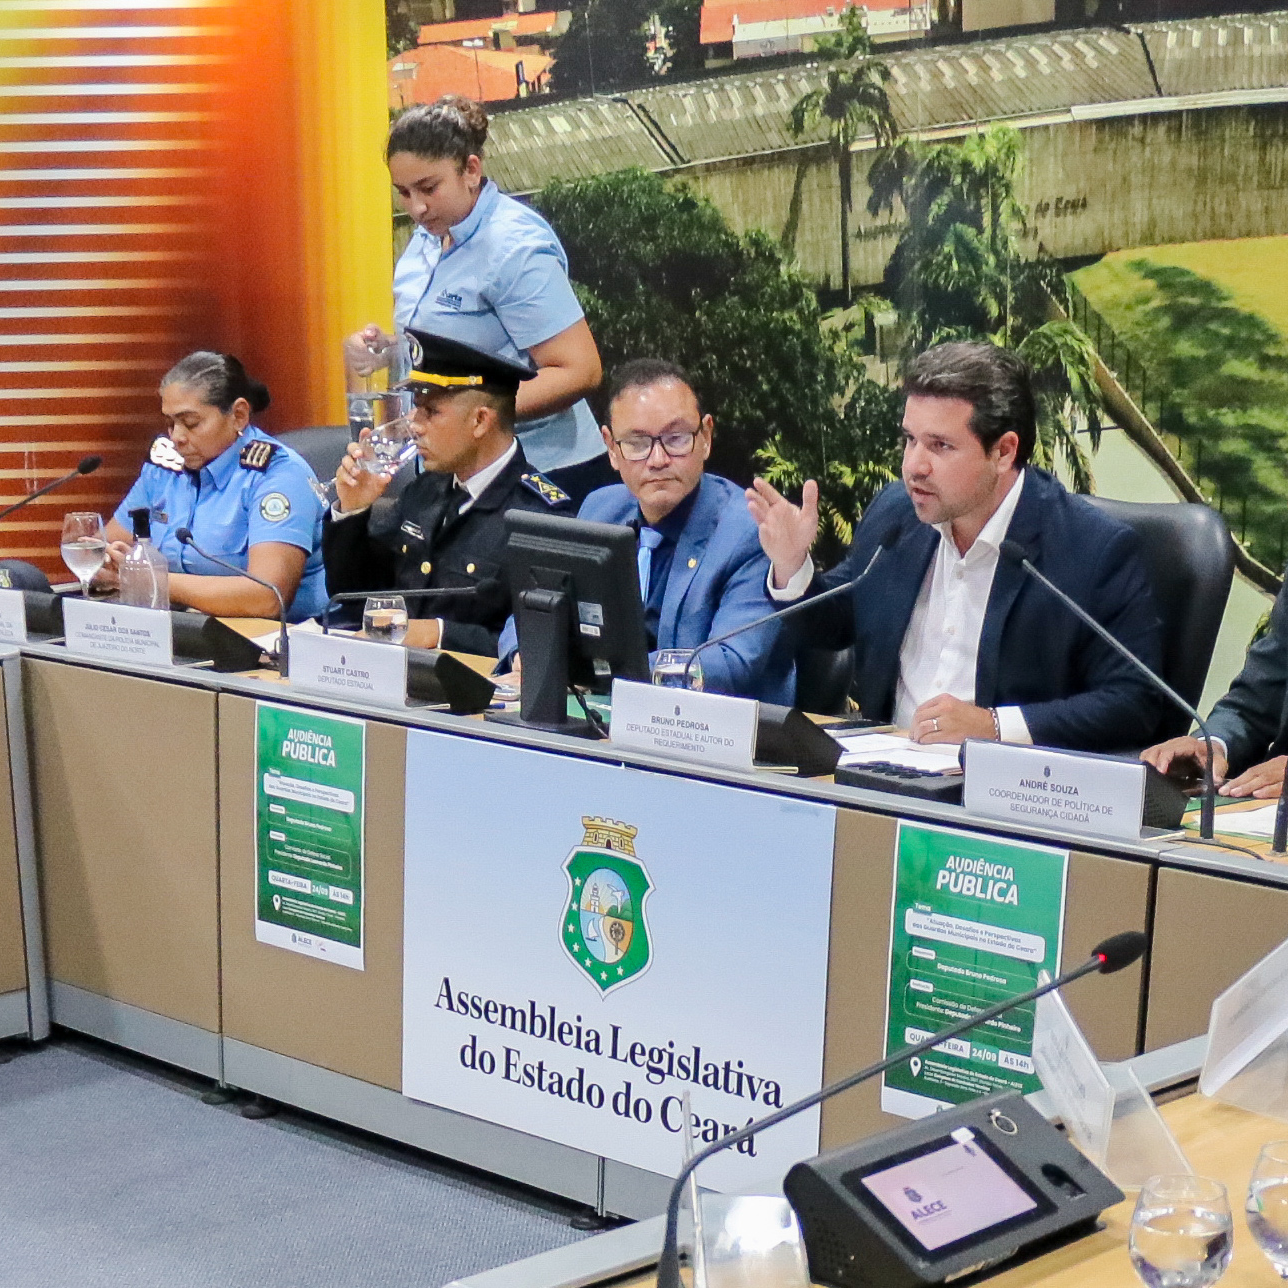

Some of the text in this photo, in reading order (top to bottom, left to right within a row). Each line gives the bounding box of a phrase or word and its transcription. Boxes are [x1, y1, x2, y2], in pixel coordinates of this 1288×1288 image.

[323, 665, 369, 678] STUART CASTRO
[318, 675, 374, 690] DEPUTADO ESTADUAL
[651, 715, 709, 732] BRUNO PEDROSA
[288, 728, 332, 748] AUDIÊNCIA
[626, 723, 660, 735] DEPUTADO
[661, 728, 693, 740] ESTADUAL
[700, 735, 723, 746] AUTOR
[724, 738, 734, 746] DO
[282, 739, 336, 767] PÚBLICA
[654, 738, 705, 752] REQUERIMENTO
[1019, 779, 1079, 796] ANDRÉ SOUZA
[989, 788, 1113, 815] COORDENADOR DE POLÍTICA DE
[1010, 803, 1058, 819] SEGURANÇA
[945, 855, 1015, 881] AUDIÊNCIA
[271, 874, 307, 889] QUARTA-FEIRA
[312, 884, 329, 895] 24/09
[935, 868, 1019, 906] PÚBLICA
[915, 903, 932, 912] Tema
[434, 976, 784, 1109] Assembleia Legislativa
[972, 1047, 997, 1062] 24/09
[1015, 1057, 1029, 1070] 14h
[459, 1034, 758, 1158] do Estado do Ceará
[911, 1200, 947, 1220] ALECE
